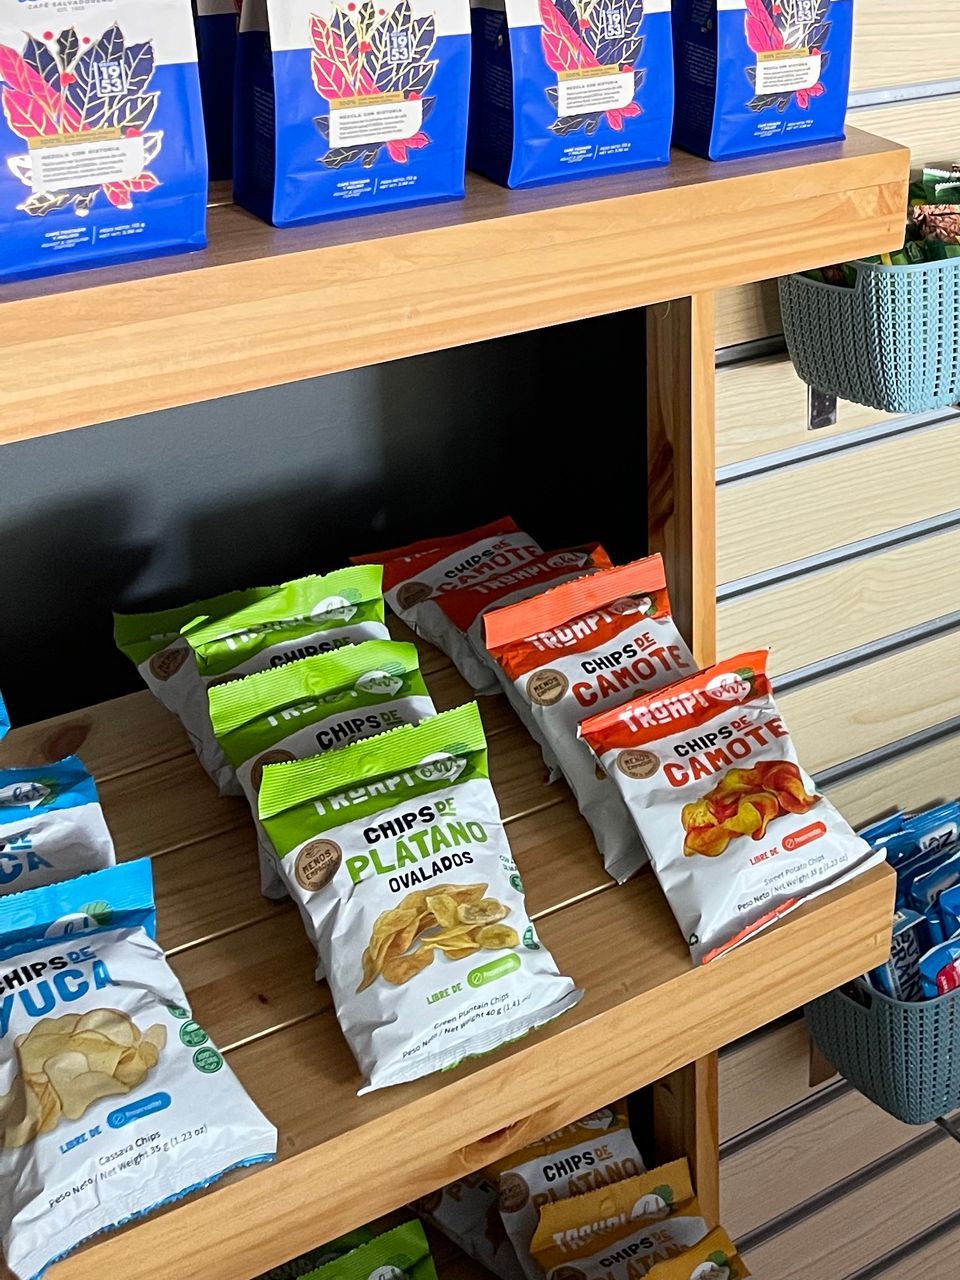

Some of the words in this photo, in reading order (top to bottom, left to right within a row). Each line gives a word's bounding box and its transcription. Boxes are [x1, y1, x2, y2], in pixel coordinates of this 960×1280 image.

[607, 14, 620, 25] 19
[797, 0, 810, 11] 19
[798, 10, 811, 21] 53
[391, 36, 408, 49] 19
[607, 24, 622, 37] 53
[391, 48, 409, 61] 53
[100, 66, 120, 80] 19
[101, 79, 122, 93] 53
[435, 545, 538, 593] CAMOTE
[444, 549, 494, 579] CHIPS
[469, 563, 549, 594] TROMPI
[524, 610, 613, 651] TROMPI
[581, 644, 638, 675] CHIPS
[634, 631, 657, 651] DE
[533, 676, 558, 692] MENOS
[571, 645, 691, 708] CAMOTE
[618, 688, 709, 733] TROMPI
[316, 715, 381, 751] CHIPS
[380, 709, 403, 727] DE
[673, 726, 733, 757] CHIPS
[730, 715, 754, 732] DE
[625, 754, 651, 766] MENOS
[663, 718, 790, 788] CAMOTE
[363, 806, 435, 845] CHIPS
[434, 797, 457, 817] DE
[302, 849, 333, 874] MENOS
[346, 820, 489, 885] PLÁTANO
[750, 851, 769, 866] LIBRE
[770, 847, 779, 857] DE
[388, 851, 474, 893] OVALADOS
[764, 871, 784, 886] Sweet
[785, 862, 808, 876] Potato
[808, 854, 825, 867] Chips
[737, 900, 754, 912] Peso
[754, 890, 771, 903] Neto
[786, 873, 810, 889] Weight
[67, 945, 97, 964] DE
[0, 959, 114, 1038] YUCA
[427, 987, 451, 1005] LIBRE
[452, 982, 464, 995] DE
[434, 1014, 458, 1030] Green
[458, 1001, 489, 1021] Plantain
[490, 992, 510, 1007] Chips
[402, 1046, 421, 1059] Peso
[444, 1025, 460, 1035] Net
[460, 1012, 485, 1030] Weight
[485, 1008, 495, 1017] 40
[59, 1132, 88, 1155] LIBRE
[89, 1125, 102, 1139] DE
[98, 1144, 134, 1166] Cassava
[134, 1130, 161, 1148] Chips
[49, 1191, 71, 1209] Peso
[100, 1167, 118, 1181] Net
[118, 1151, 149, 1172] Weight
[149, 1144, 162, 1155] 35
[194, 1122, 208, 1136] oz)
[543, 1151, 595, 1182] CHIPS
[594, 1144, 613, 1161] DE
[599, 1237, 654, 1268] CHIPS
